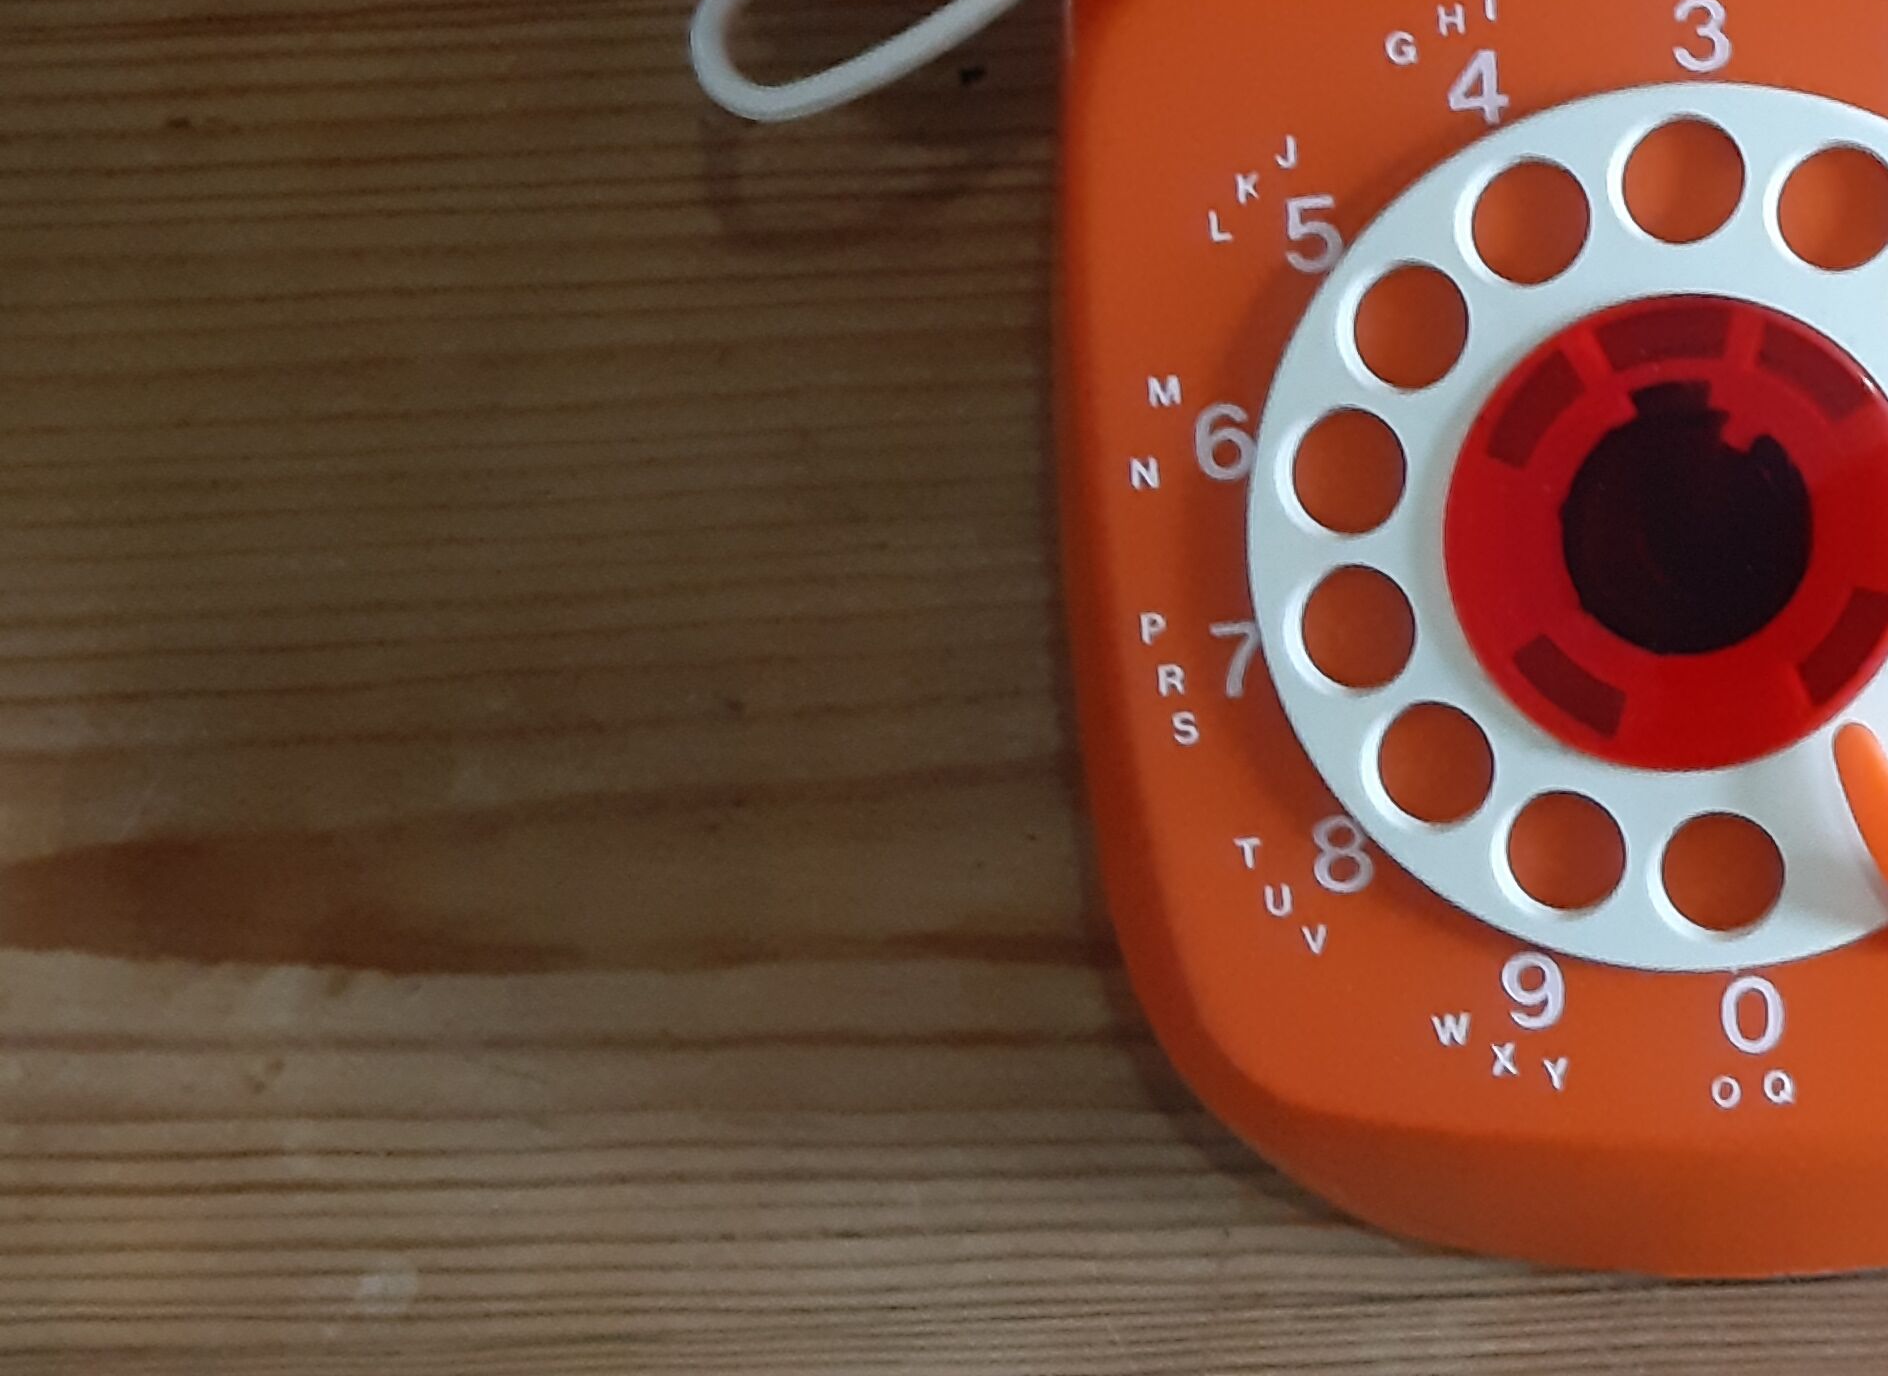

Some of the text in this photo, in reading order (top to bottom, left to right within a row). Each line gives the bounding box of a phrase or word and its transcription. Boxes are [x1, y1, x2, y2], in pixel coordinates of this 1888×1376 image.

[1447, 49, 1510, 124] 4
[1286, 194, 1345, 272] 5
[1194, 403, 1257, 482] 6
[1209, 620, 1260, 698] 7
[1312, 815, 1375, 894] 8
[1501, 952, 1565, 1030] 9
[1721, 975, 1785, 1054] 0
